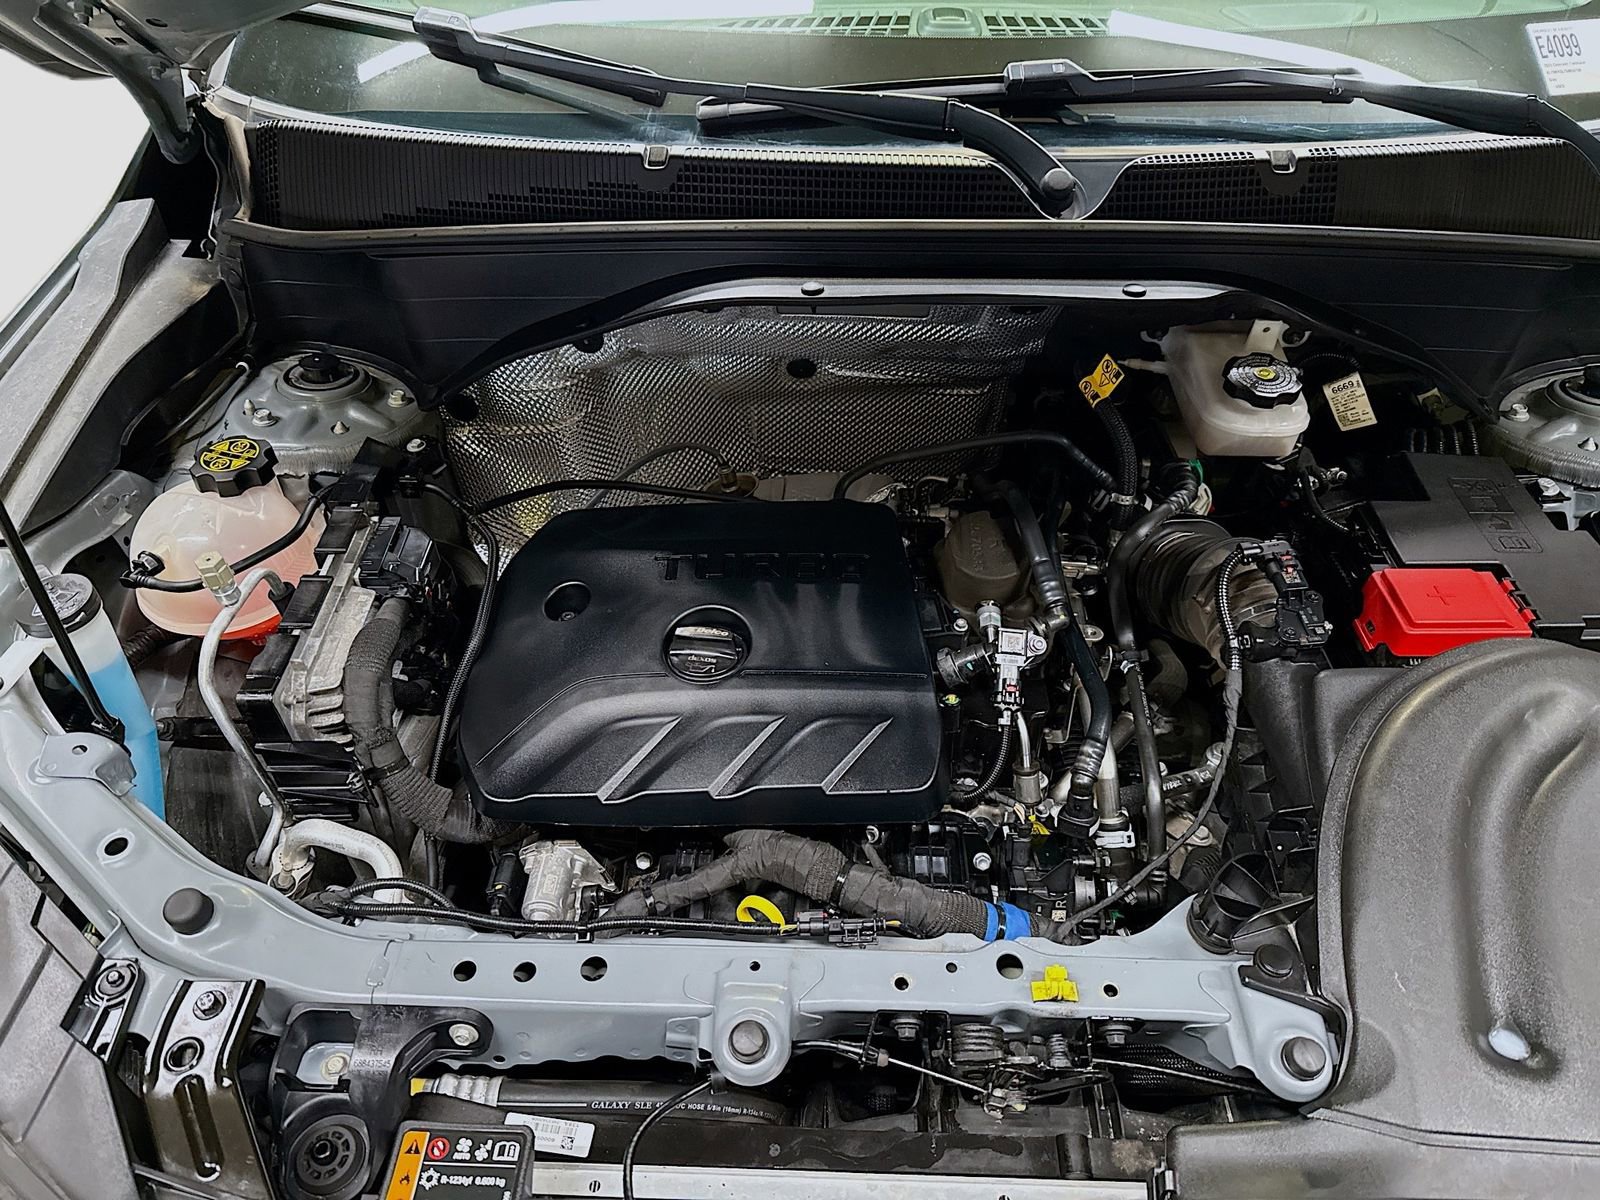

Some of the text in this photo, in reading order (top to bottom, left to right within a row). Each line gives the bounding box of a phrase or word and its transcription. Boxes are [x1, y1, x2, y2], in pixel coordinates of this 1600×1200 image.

[1535, 33, 1582, 59] E4099
[1331, 380, 1354, 394] 6669
[687, 655, 717, 663] dexos
[591, 1101, 631, 1109] GALAXY
[634, 1101, 652, 1109] SLE
[687, 1103, 705, 1111] HOSE
[452, 1152, 471, 1160] AUTO
[496, 1177, 506, 1188] kg
